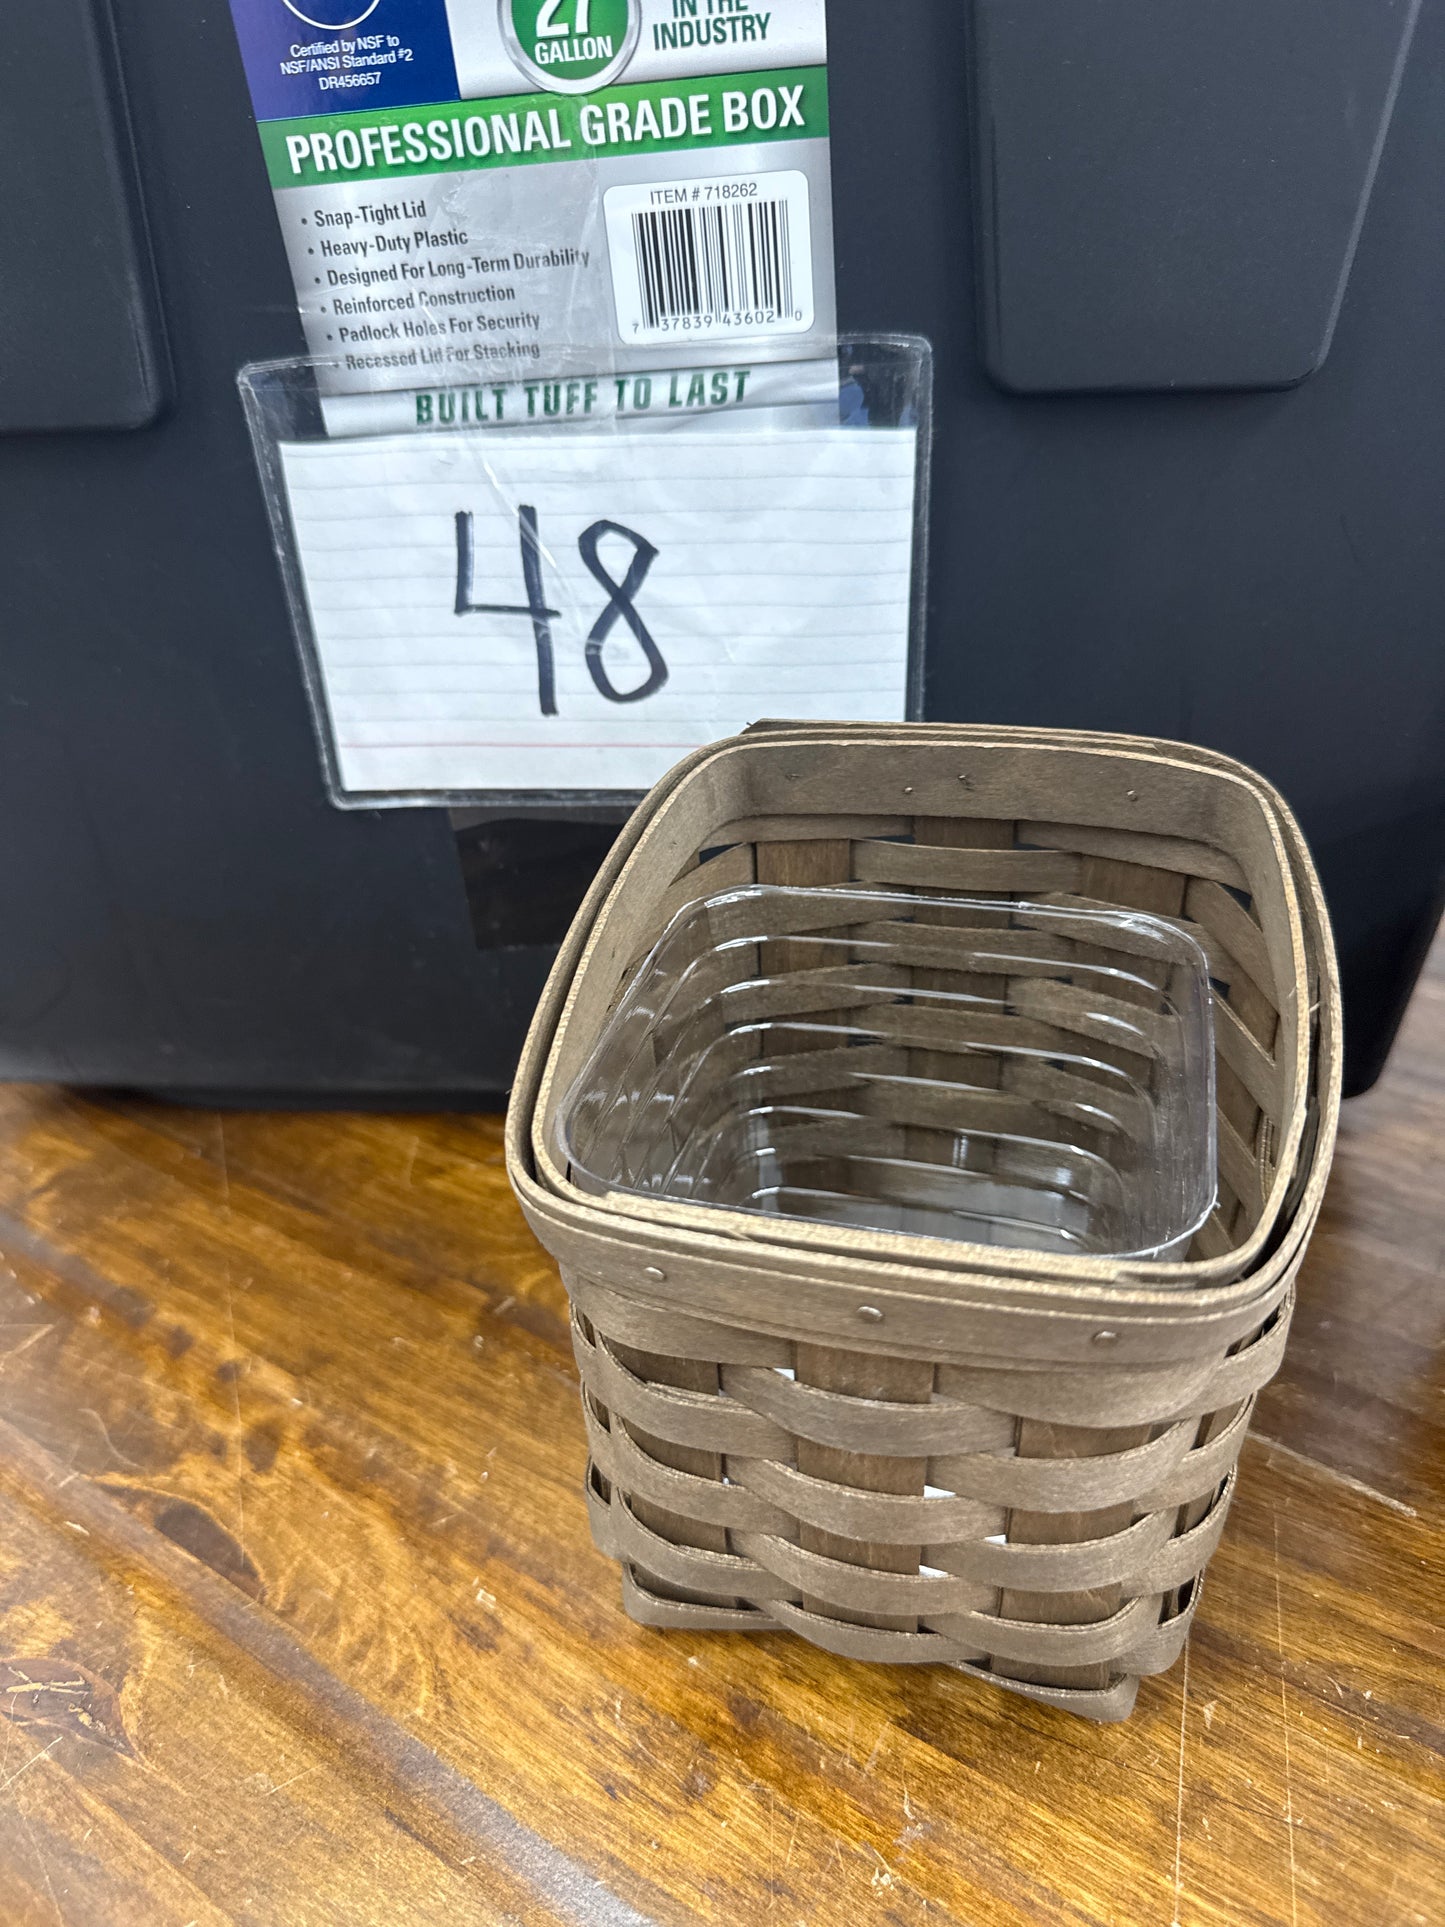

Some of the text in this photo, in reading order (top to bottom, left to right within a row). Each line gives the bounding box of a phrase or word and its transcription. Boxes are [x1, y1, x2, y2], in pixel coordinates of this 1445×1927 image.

[672, 0, 697, 18] IN
[653, 12, 772, 50] INDUSTRY
[290, 35, 400, 58] Certified by NSF to
[534, 36, 613, 64] GALLON
[280, 48, 414, 75] NSF/ANSI Standard #2
[319, 72, 382, 90] DR456657
[286, 85, 805, 174] PROFESSIONAL GRADE BOX
[650, 182, 758, 205] ITEM # 718262
[314, 200, 427, 228] Snap-Tight Lid
[320, 228, 469, 257] Heavy-Duty Plastic
[327, 248, 591, 287] Designed For Long-Term Durability
[333, 285, 516, 316] Reinforced Construction
[339, 312, 541, 343] Padlock Holes For Security
[632, 310, 803, 334] 7 37839 43602 0
[346, 341, 541, 371] Recessed Lid For Stacking
[415, 370, 752, 426] BUILT TUFF TO LAST
[454, 504, 669, 716] 48
